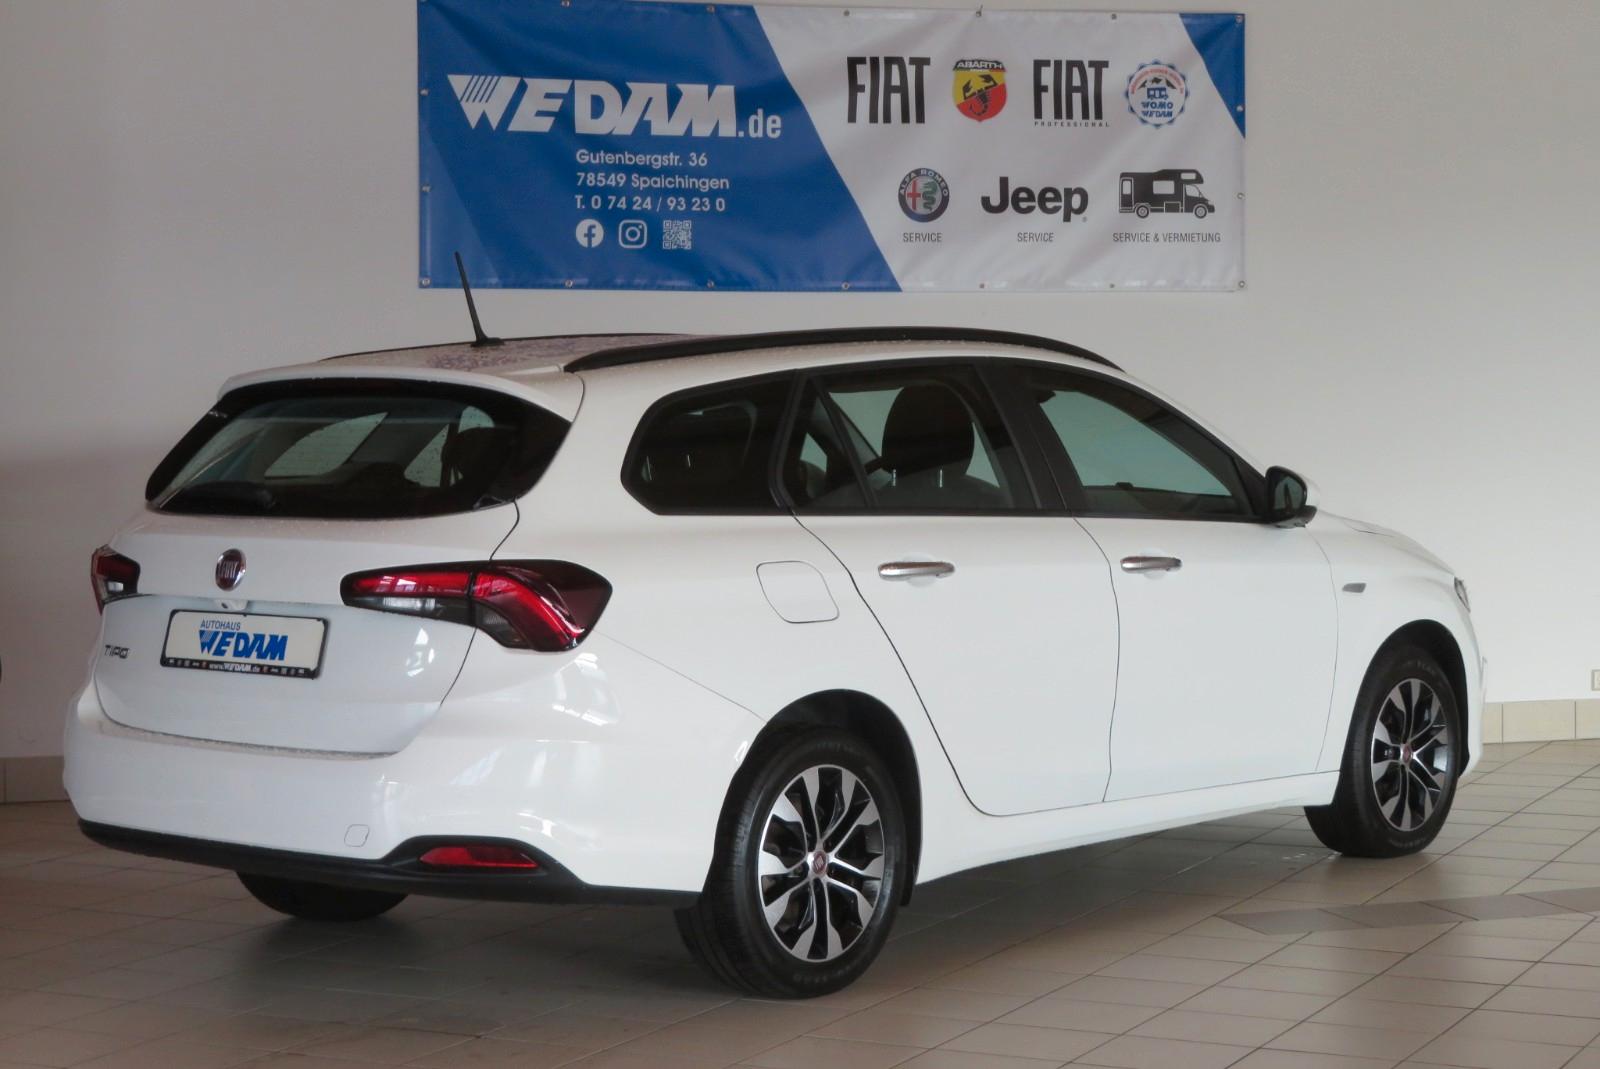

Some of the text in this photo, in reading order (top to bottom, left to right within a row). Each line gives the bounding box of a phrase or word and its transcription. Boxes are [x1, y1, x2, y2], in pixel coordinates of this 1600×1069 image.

[956, 60, 1003, 69] ABARTH
[846, 56, 931, 125] FIAT
[1033, 59, 1110, 120] FIAT
[1141, 101, 1174, 109] WOMO
[576, 149, 708, 169] Gutenbergstr. 36
[576, 172, 729, 194] 78549 Spaichingen
[900, 169, 949, 197] ALFA ROMEO
[575, 195, 586, 210] T.
[591, 196, 600, 210] 0
[607, 196, 627, 210] 74
[633, 196, 652, 210] 24
[667, 197, 687, 211] 93
[691, 197, 710, 211] 23
[716, 197, 726, 212] 0
[981, 176, 1088, 223] Jeep
[902, 232, 943, 243] SERVICE
[1016, 232, 1054, 243] SERVICE
[1112, 232, 1221, 243] SERVICE & VERMIETUNG
[200, 619, 241, 631] AUTOHAUS
[104, 645, 130, 659] TIPO
[198, 629, 289, 661] WEDAM
